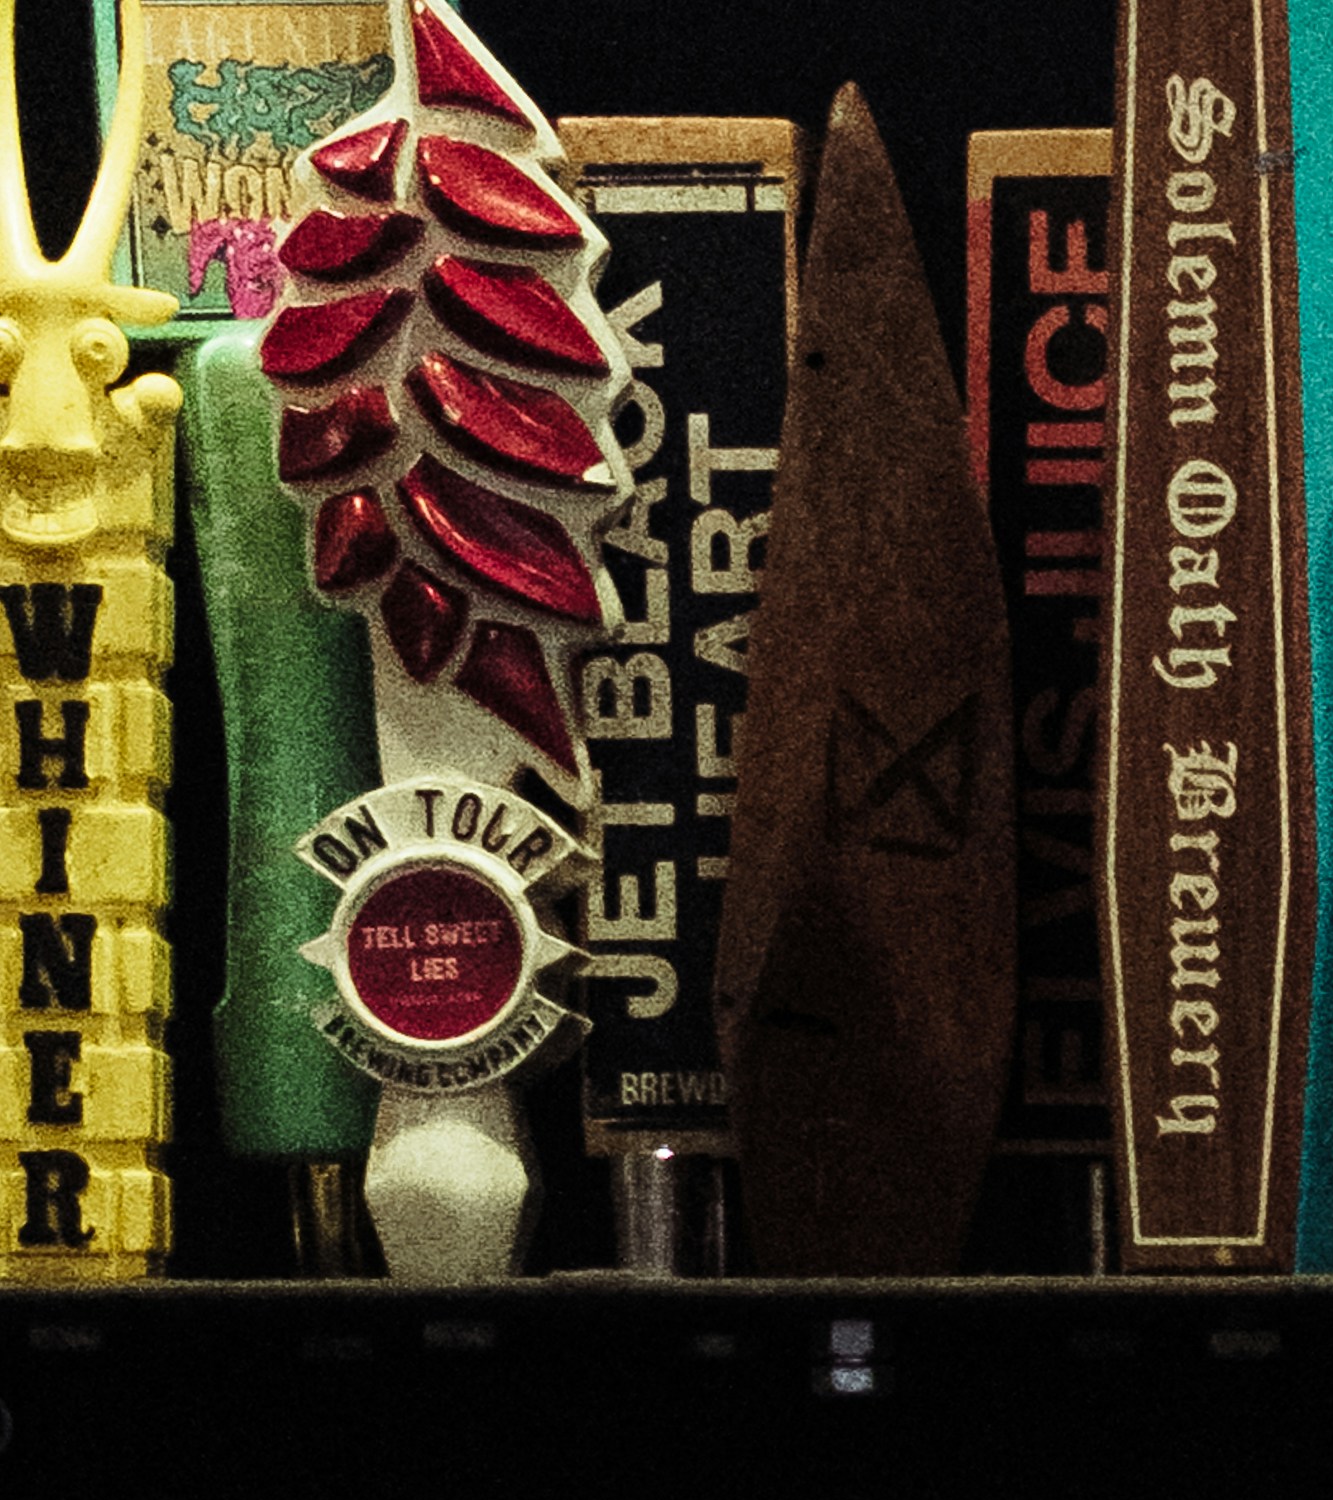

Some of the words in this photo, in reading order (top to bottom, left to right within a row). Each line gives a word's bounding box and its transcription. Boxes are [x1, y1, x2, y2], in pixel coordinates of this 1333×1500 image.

[1164, 74, 1237, 428] Solemn
[582, 280, 674, 741] BLACK
[1151, 461, 1238, 693] Oath
[0, 582, 103, 1247] WHINER
[311, 804, 389, 876] ON
[415, 788, 560, 877] TOUR
[361, 925, 416, 952] TELL
[424, 918, 506, 950] SWEET
[585, 802, 679, 1021] JET
[1155, 741, 1240, 1139] Brewery
[322, 1012, 432, 1089] BREWING
[436, 1008, 551, 1089] COMPANY
[409, 954, 460, 983] LIES
